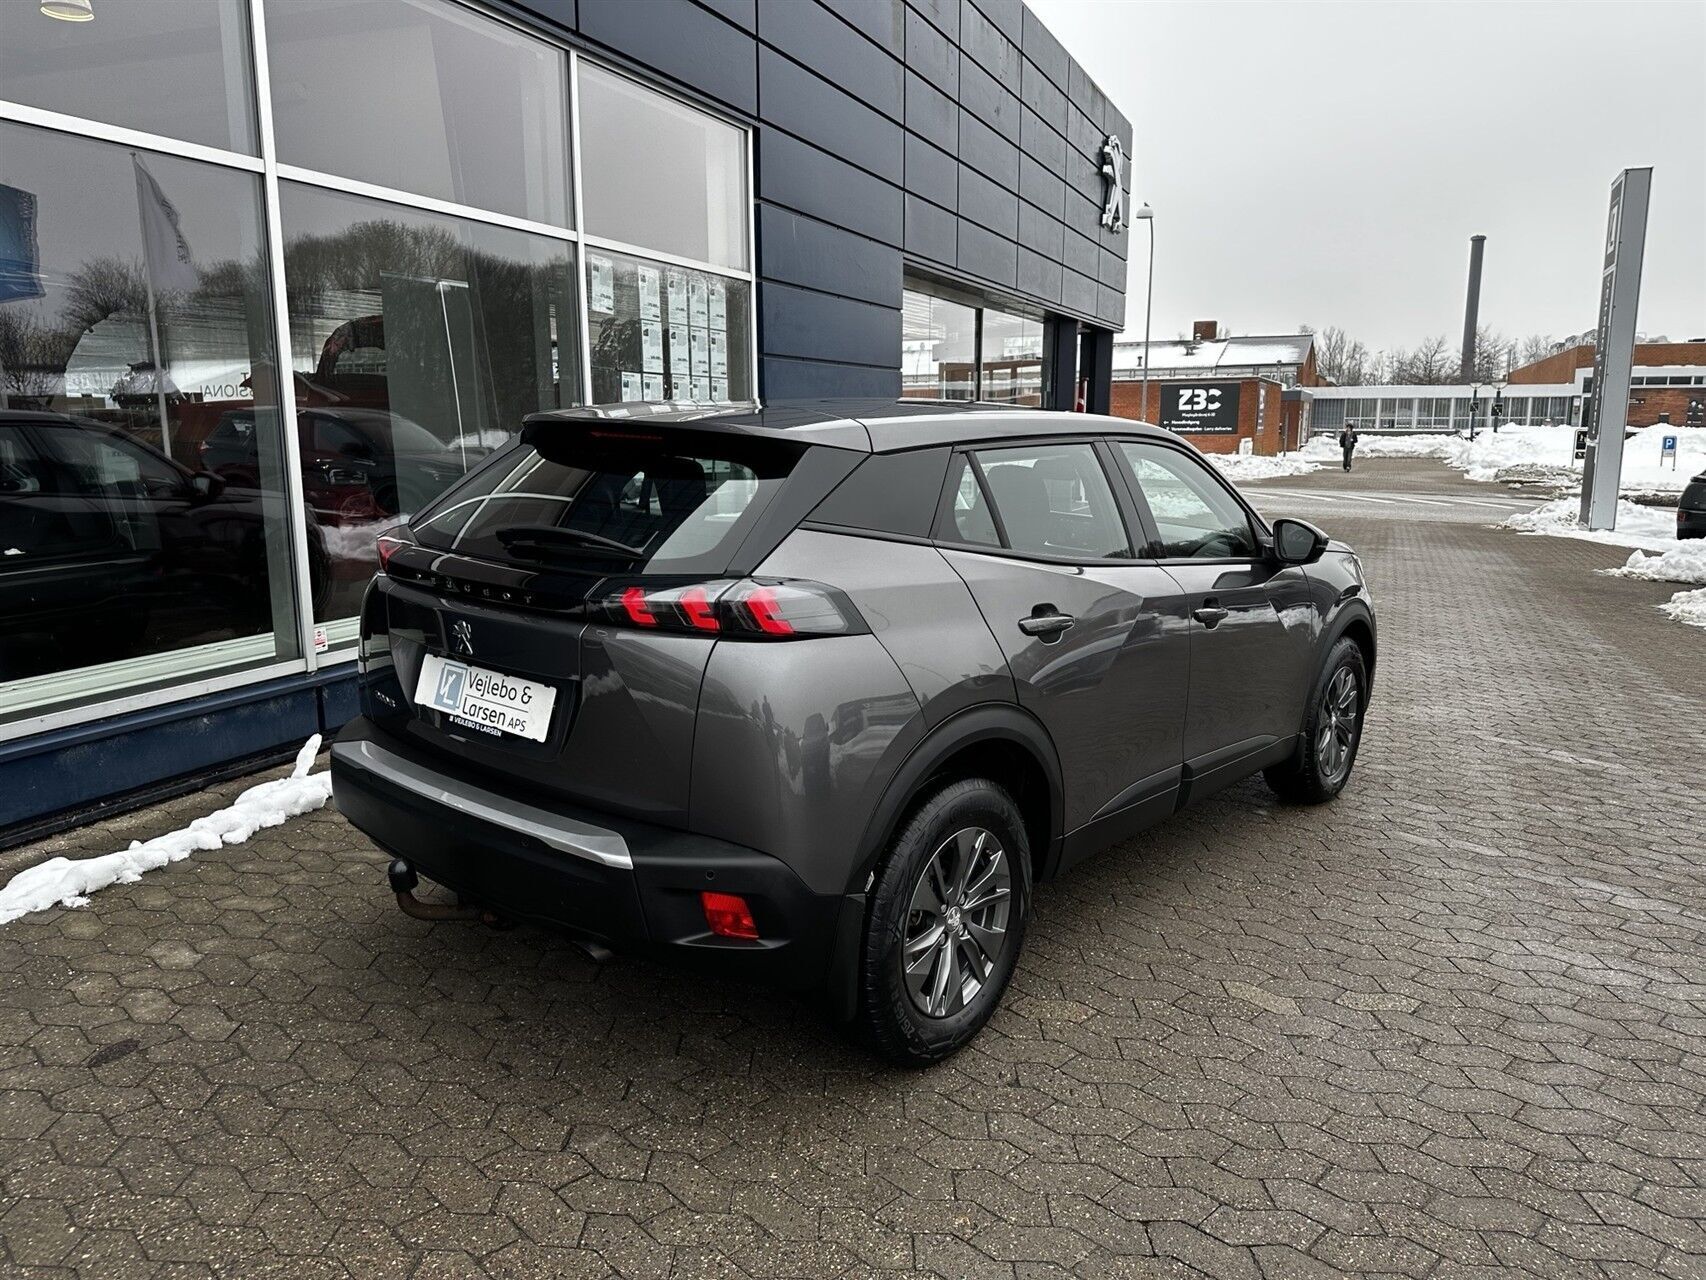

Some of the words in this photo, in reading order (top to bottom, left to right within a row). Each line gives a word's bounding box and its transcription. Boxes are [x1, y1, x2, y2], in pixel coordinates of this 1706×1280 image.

[1665, 438, 1673, 449] P
[469, 671, 517, 701] Vejlebo
[521, 686, 532, 704] &
[462, 697, 506, 726] Larsen
[507, 717, 527, 732] APS
[480, 725, 502, 737] LARSEN
